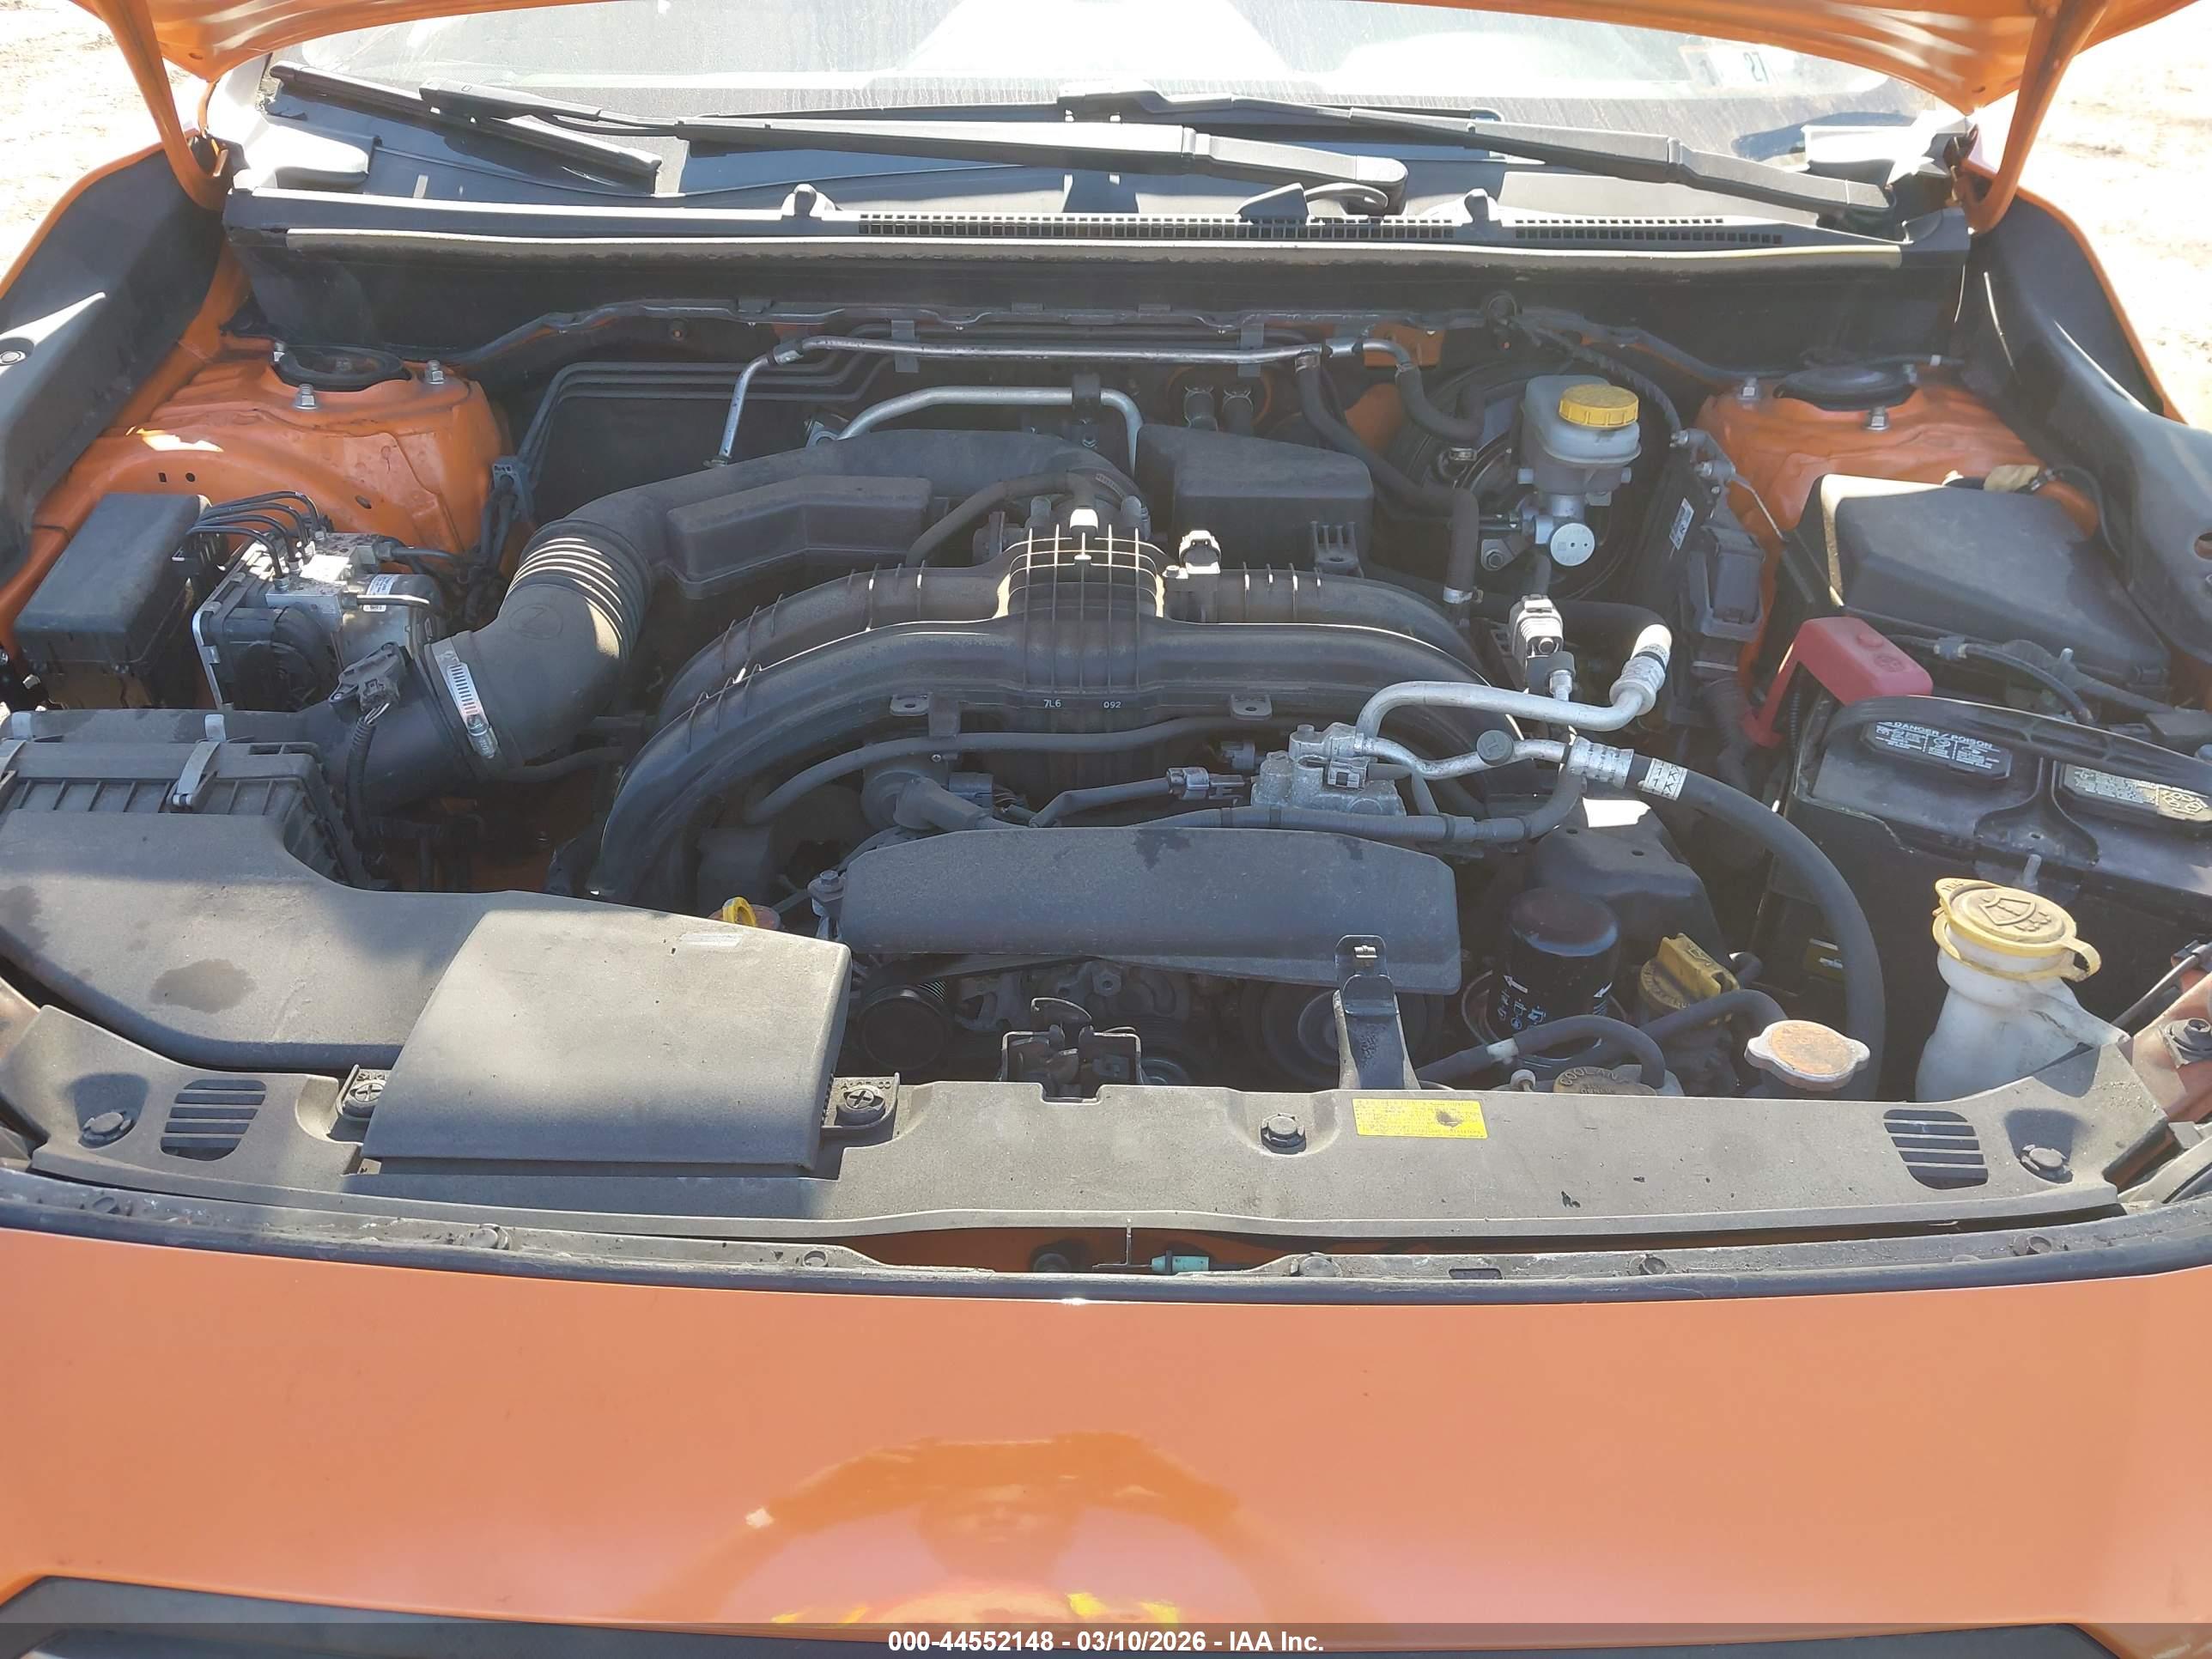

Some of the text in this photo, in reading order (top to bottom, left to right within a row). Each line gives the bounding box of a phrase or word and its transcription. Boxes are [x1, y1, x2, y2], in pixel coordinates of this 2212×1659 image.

[1043, 699, 1061, 708] 7L6
[1893, 721, 1940, 737] DANGER
[1950, 733, 1993, 749] POISON
